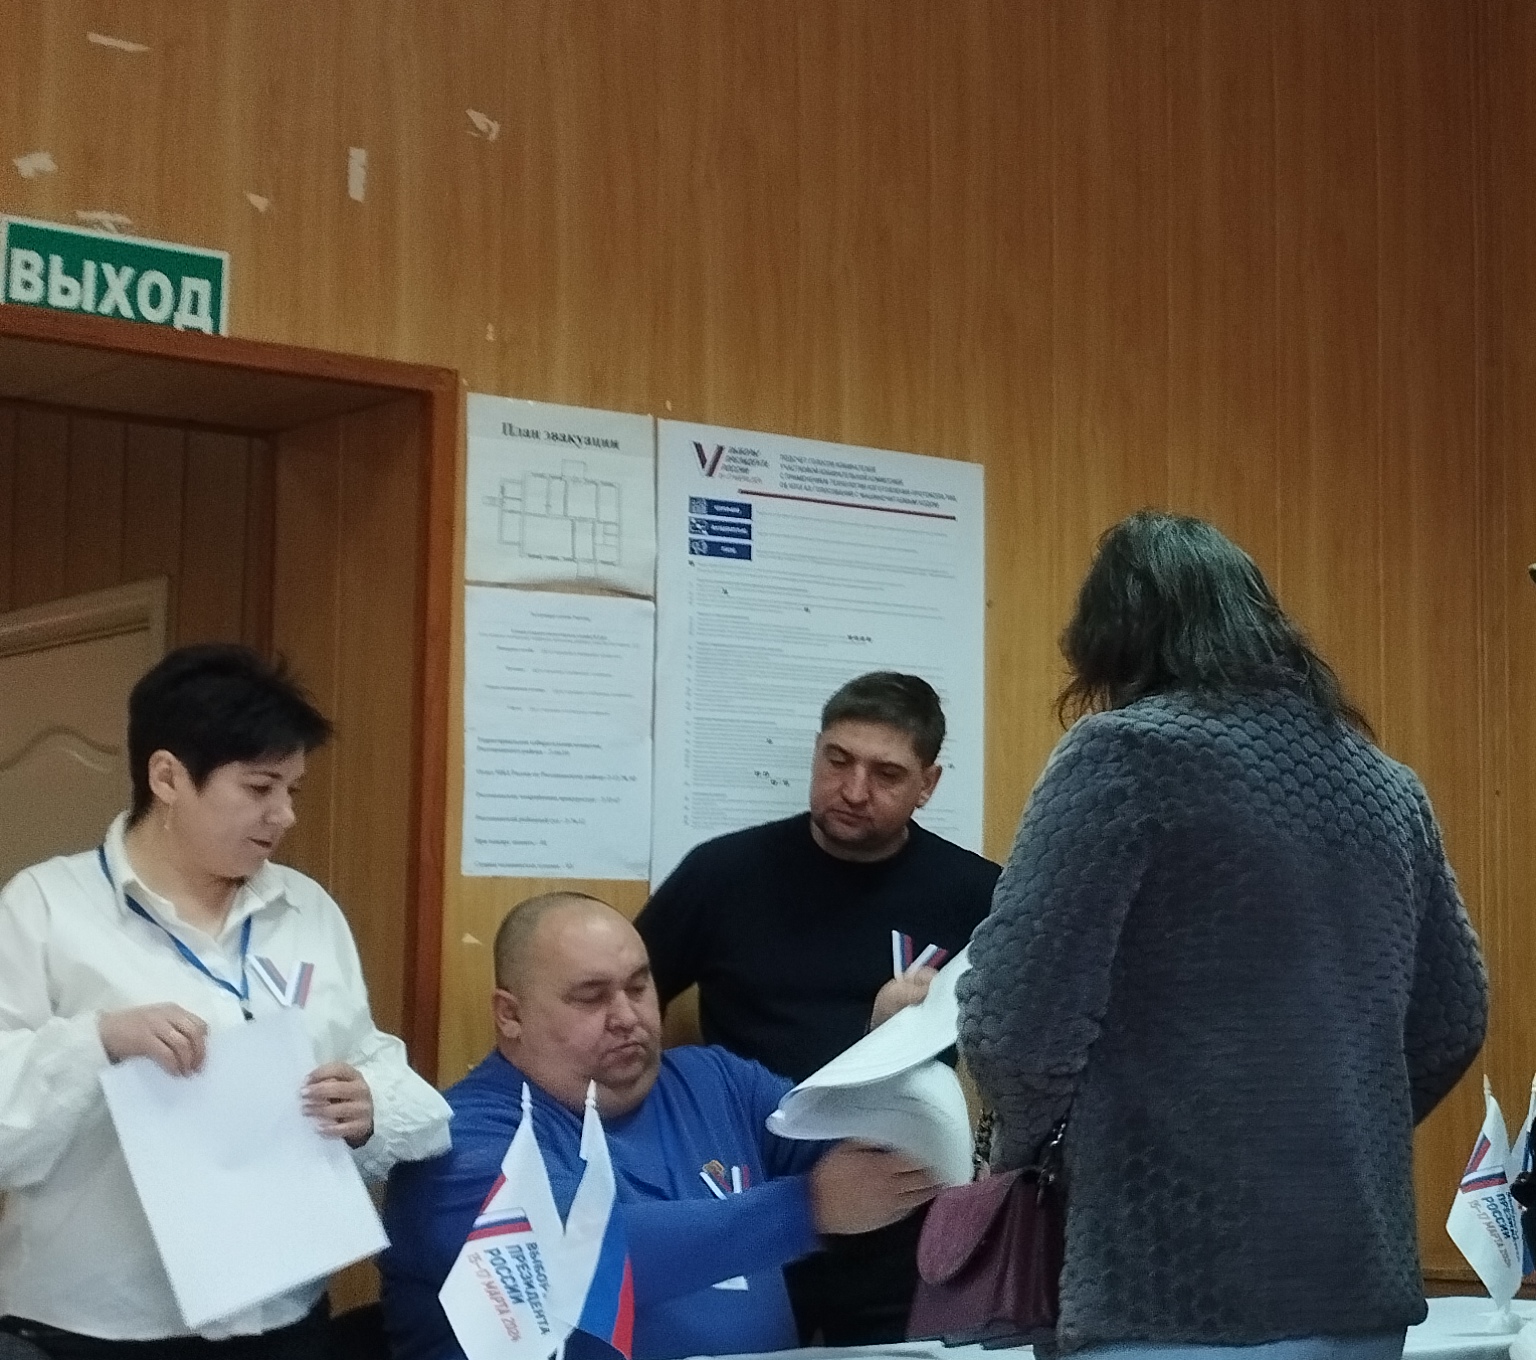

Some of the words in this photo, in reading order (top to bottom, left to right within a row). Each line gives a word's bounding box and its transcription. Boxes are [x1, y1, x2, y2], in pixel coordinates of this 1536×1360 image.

[8, 246, 214, 336] ВЫХОД
[1481, 1196, 1510, 1239] РОССИИ
[483, 1247, 525, 1305] РОССИИ
[505, 1244, 550, 1335] ПРЕЗИДЕНТА
